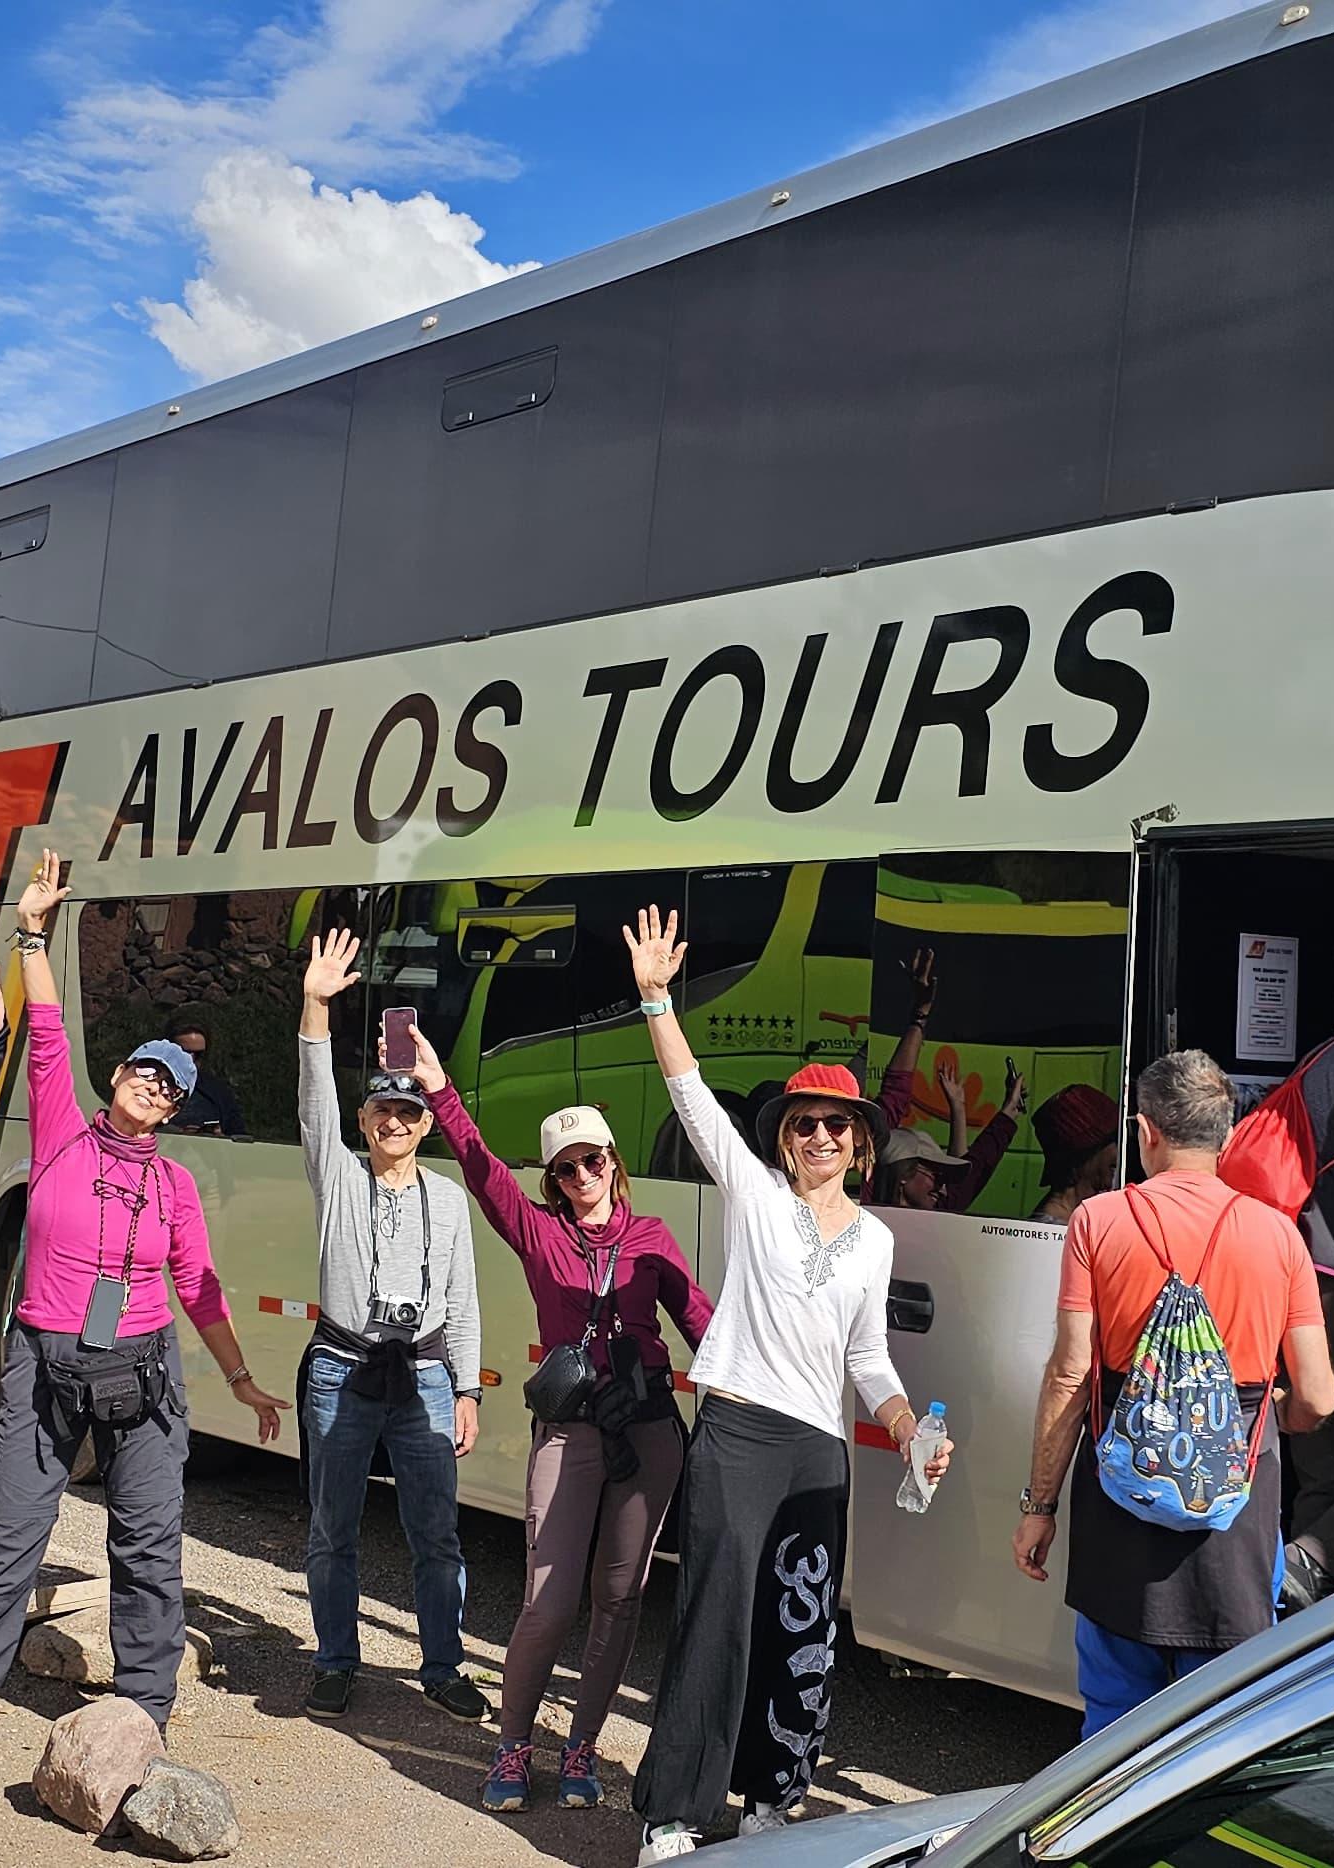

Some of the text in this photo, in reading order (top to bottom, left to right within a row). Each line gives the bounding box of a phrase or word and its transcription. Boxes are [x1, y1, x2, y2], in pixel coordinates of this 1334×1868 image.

[99, 570, 1176, 862] AVALOS TOURS
[558, 1112, 579, 1133] D
[980, 1224, 1050, 1241] AUTOMOTORES
